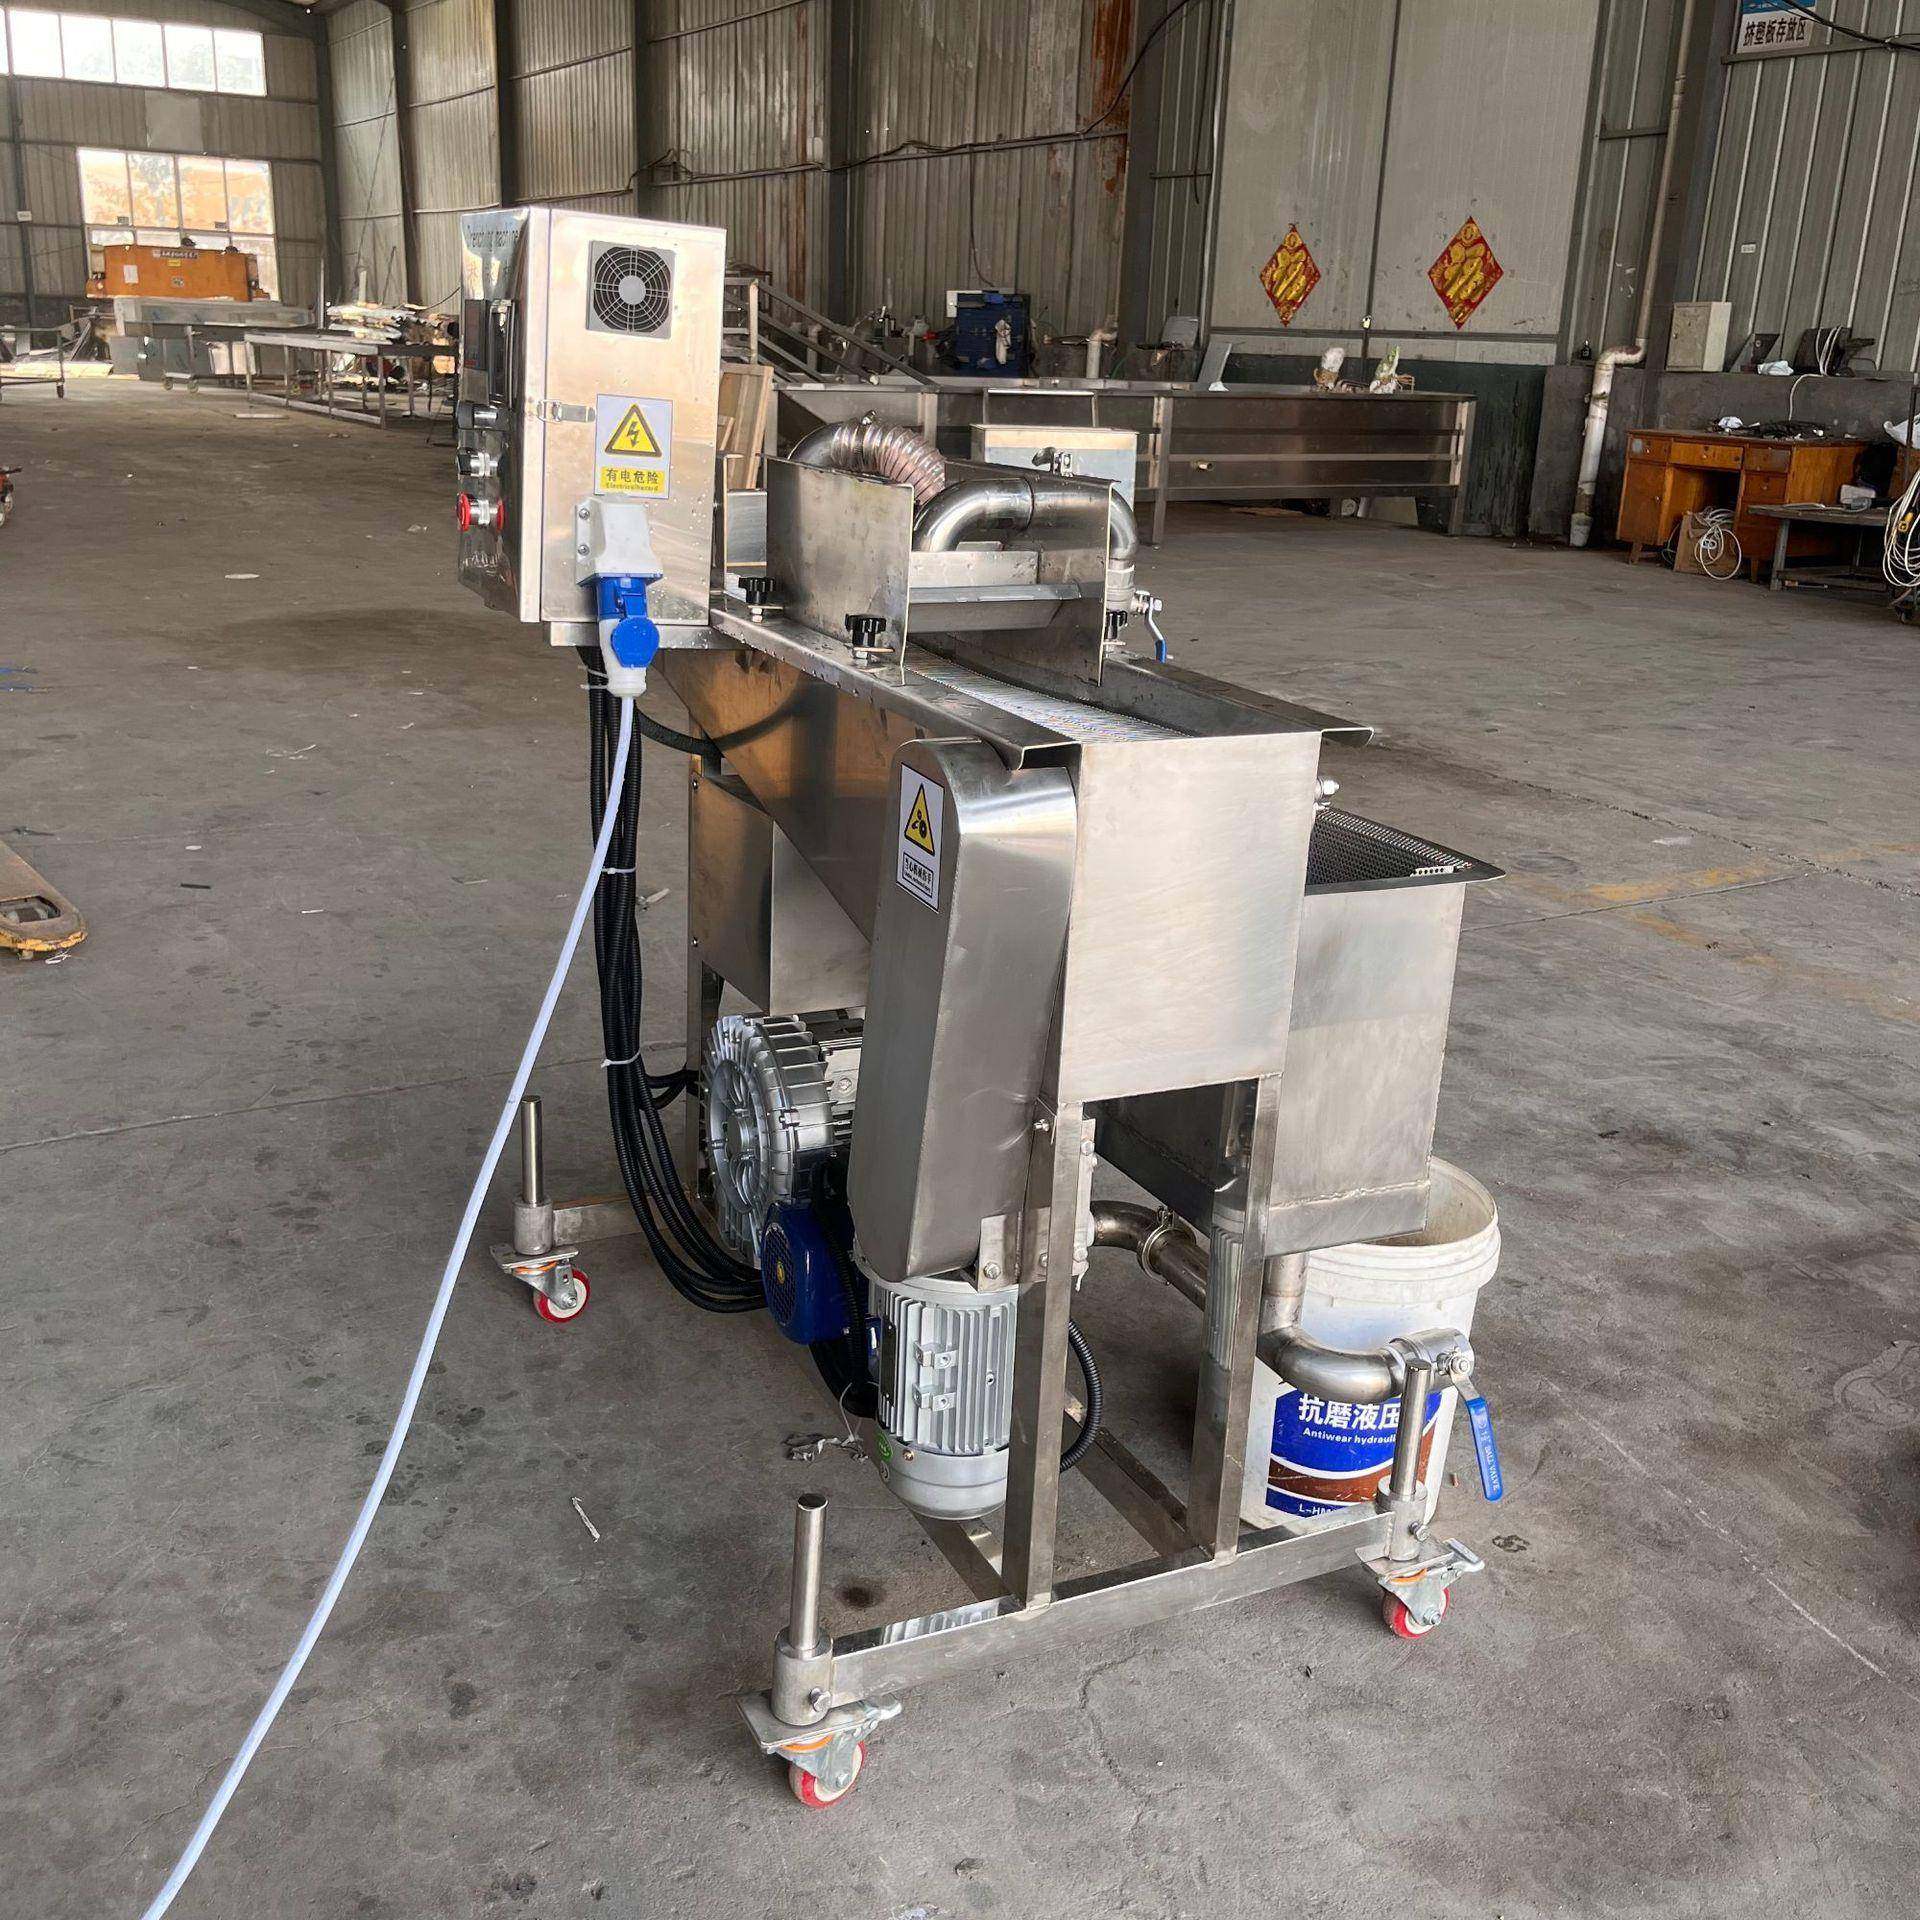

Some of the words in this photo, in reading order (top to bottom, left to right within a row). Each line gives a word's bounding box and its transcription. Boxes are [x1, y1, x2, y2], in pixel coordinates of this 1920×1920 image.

[606, 467, 659, 484] 有电危险
[1298, 1393, 1401, 1431] 抗磨液压
[1303, 1427, 1352, 1443] Antiwear
[1489, 1465, 1500, 1491] VALVE
